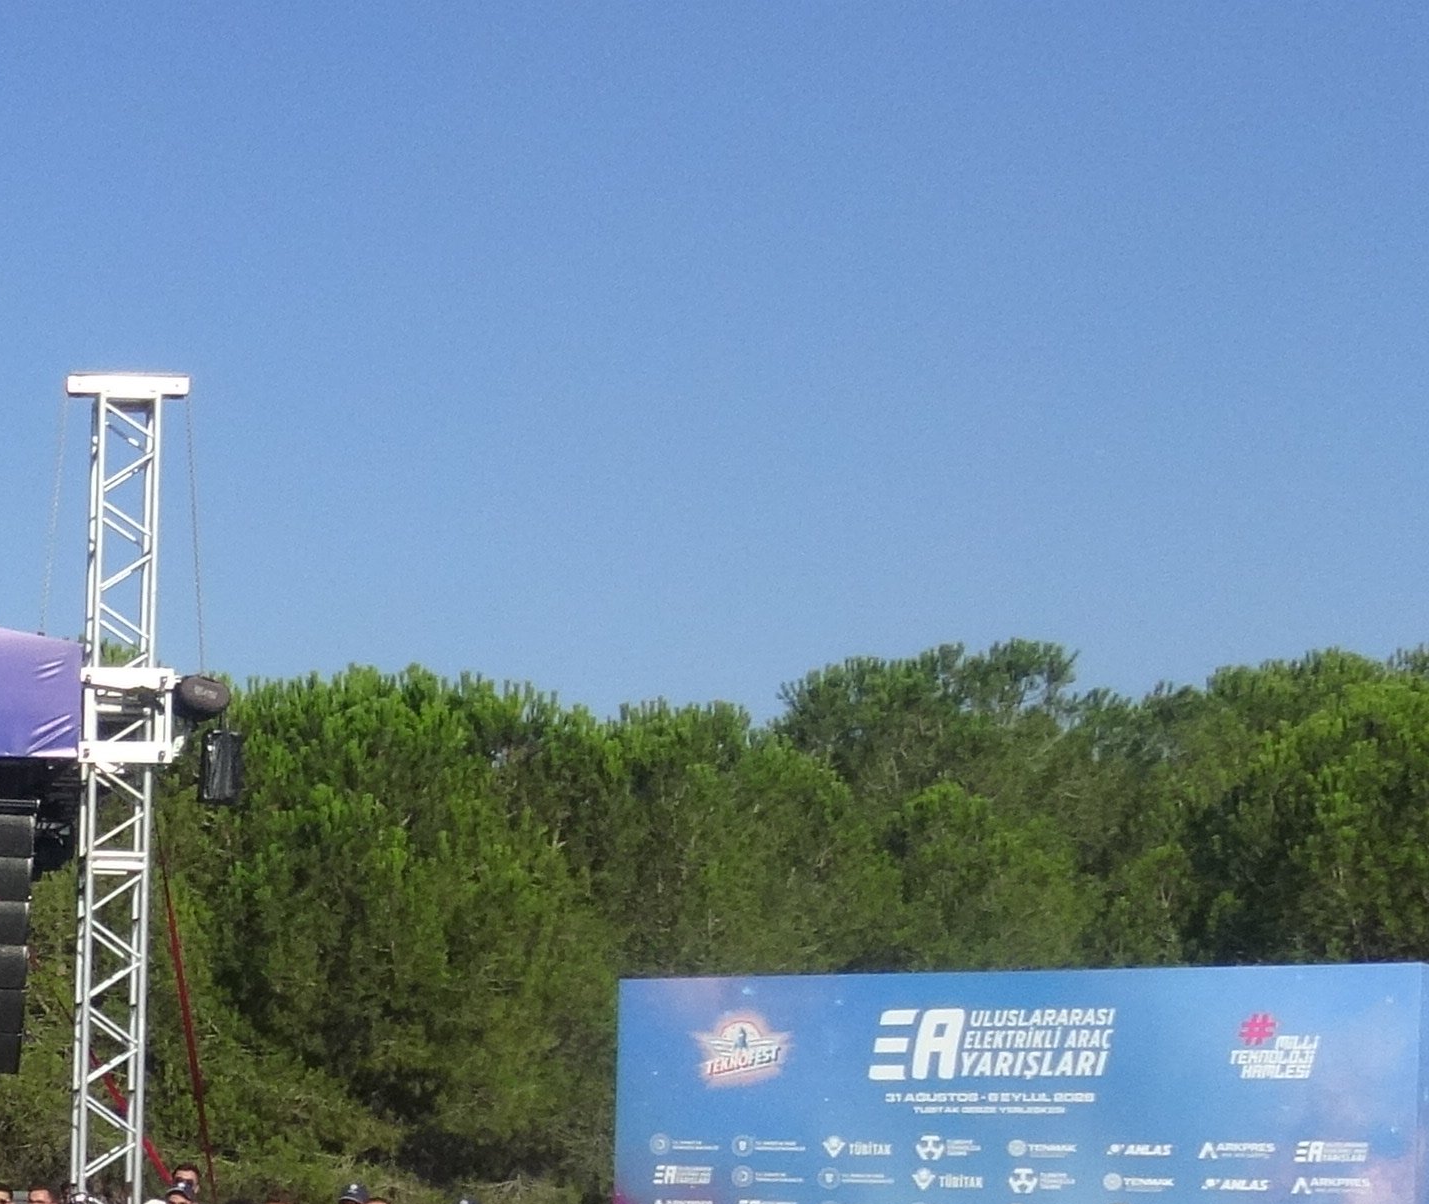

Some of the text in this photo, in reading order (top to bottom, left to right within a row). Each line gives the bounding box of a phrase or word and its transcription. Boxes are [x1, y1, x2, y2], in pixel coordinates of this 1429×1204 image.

[970, 1008, 1116, 1027] ULUSLARARASI
[963, 1027, 1114, 1050] ELEKTRİKLİ ARAÇ
[706, 1046, 781, 1075] TEKNOFEST
[960, 1051, 1109, 1080] YARIŞLARI
